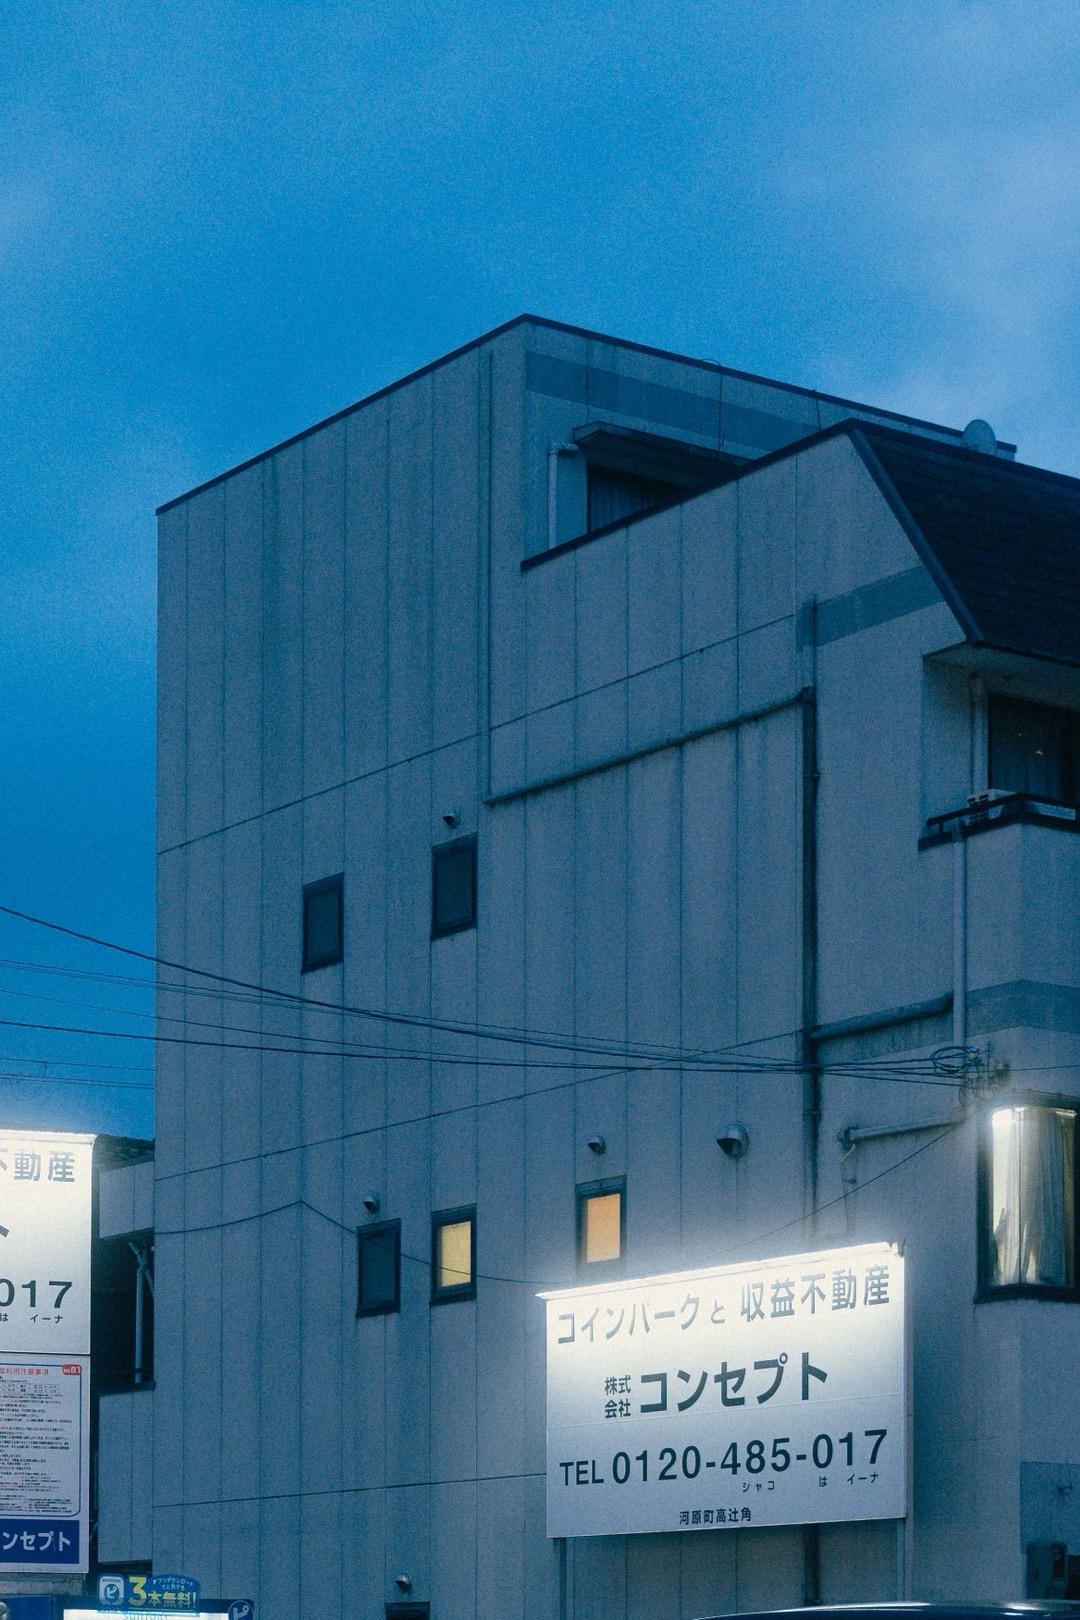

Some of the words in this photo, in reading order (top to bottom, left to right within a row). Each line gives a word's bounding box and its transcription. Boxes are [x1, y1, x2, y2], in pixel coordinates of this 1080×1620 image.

[0, 1312, 9, 1322] は
[640, 1352, 828, 1414] コンセプト
[559, 1460, 604, 1486] TEL
[612, 1429, 888, 1484] 0120-485-017
[818, 1476, 827, 1487] は
[679, 1507, 752, 1526] 河原町高辻角
